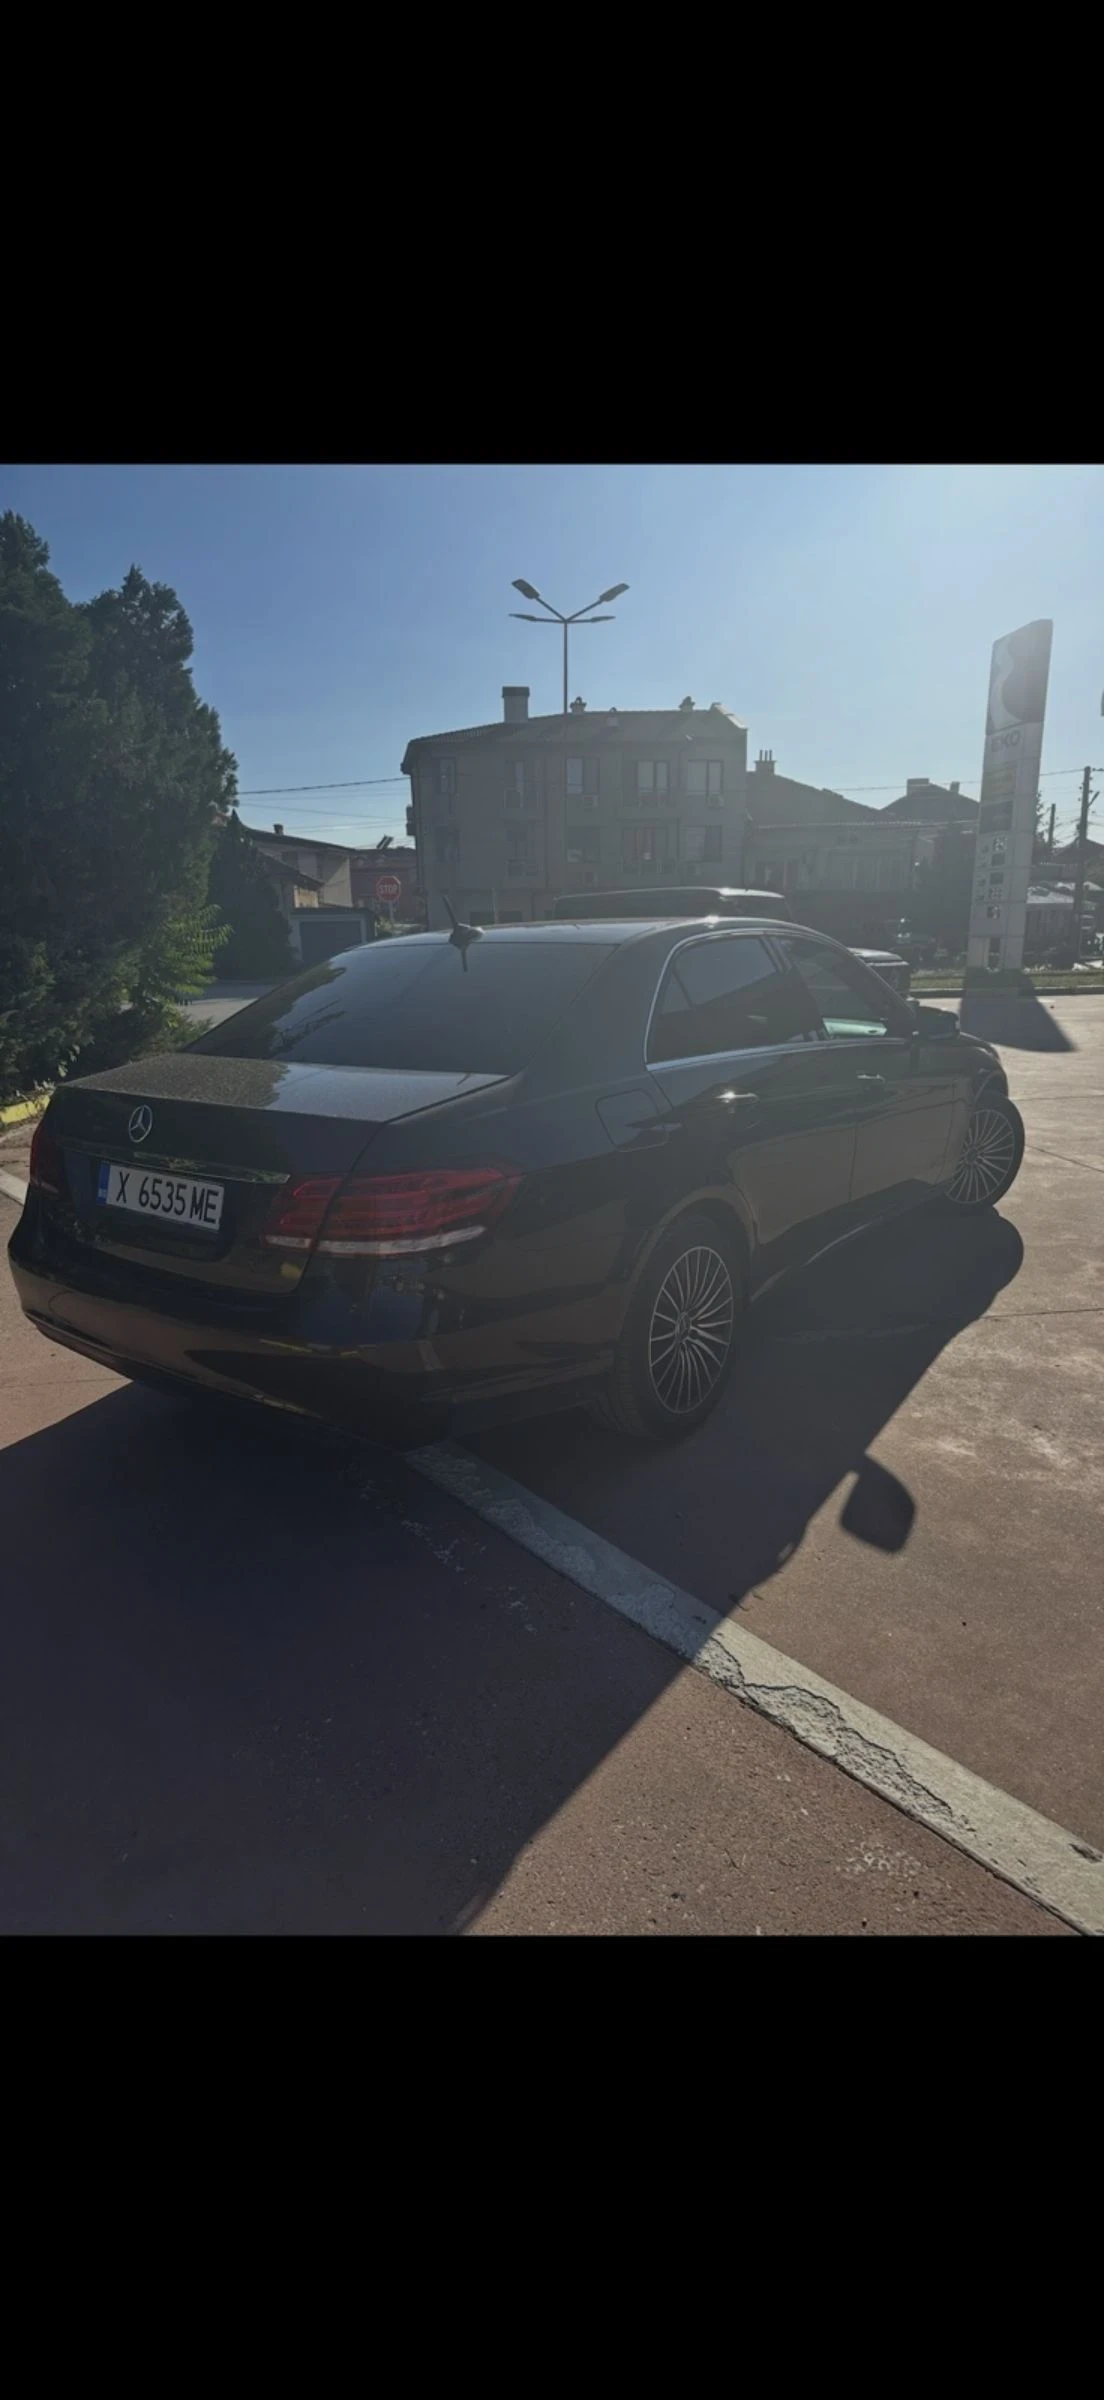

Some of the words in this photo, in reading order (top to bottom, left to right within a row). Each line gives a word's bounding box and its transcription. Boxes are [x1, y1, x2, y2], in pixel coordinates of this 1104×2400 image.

[990, 729, 1022, 752] EKO
[378, 884, 398, 895] STOP
[115, 1171, 131, 1204] X
[138, 1176, 188, 1216] 6535
[189, 1185, 220, 1225] ME
